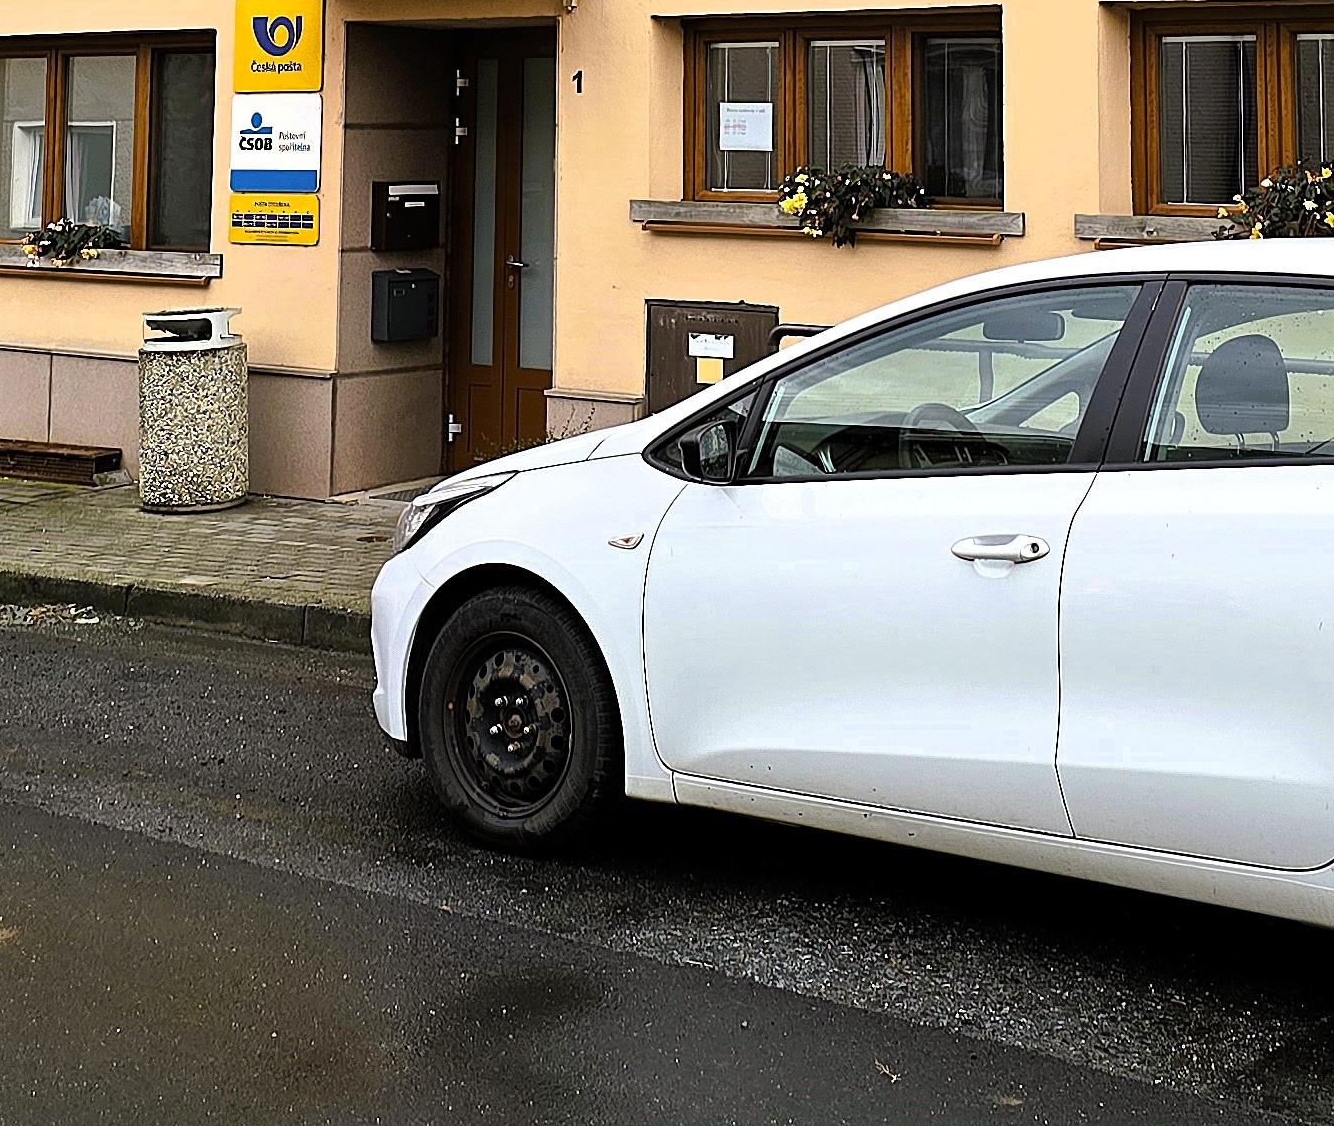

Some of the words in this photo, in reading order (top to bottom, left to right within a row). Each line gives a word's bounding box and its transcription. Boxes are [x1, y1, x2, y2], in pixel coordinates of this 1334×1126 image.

[250, 60, 276, 72] Česká
[277, 61, 302, 74] pošta
[572, 70, 582, 93] 1
[238, 135, 273, 151] ČSOB
